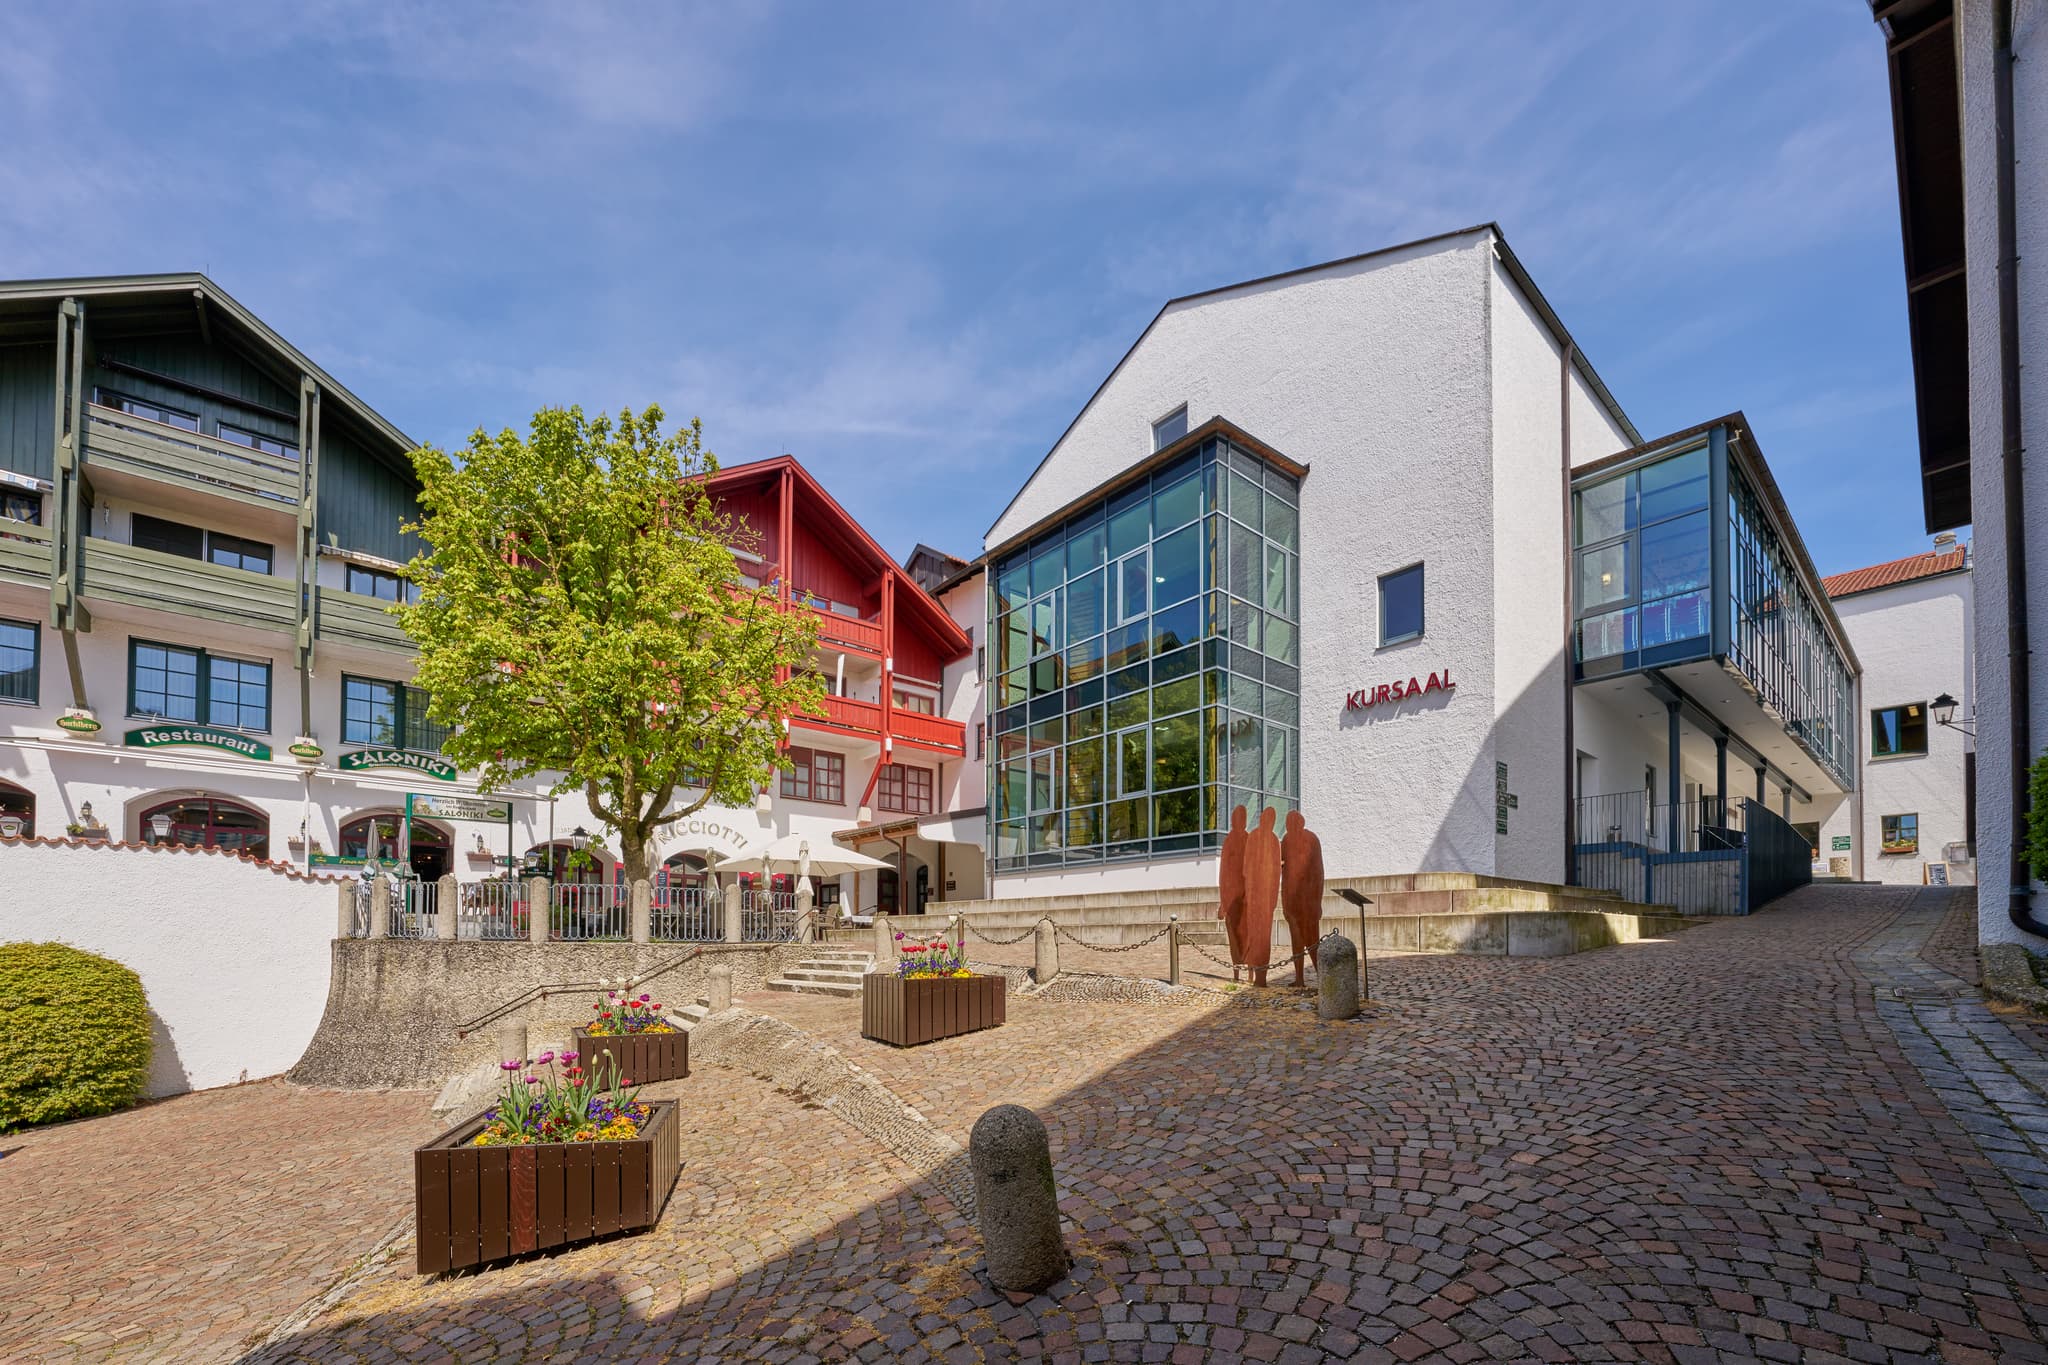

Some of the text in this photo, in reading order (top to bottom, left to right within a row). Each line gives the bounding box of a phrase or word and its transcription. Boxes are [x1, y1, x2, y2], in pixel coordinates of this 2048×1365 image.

[1346, 668, 1456, 711] KURSAAL
[141, 729, 258, 754] Restaurant
[348, 751, 450, 776] SALONIKI
[438, 809, 484, 819] SALONIKI
[657, 820, 748, 849] RICCIOTTI
